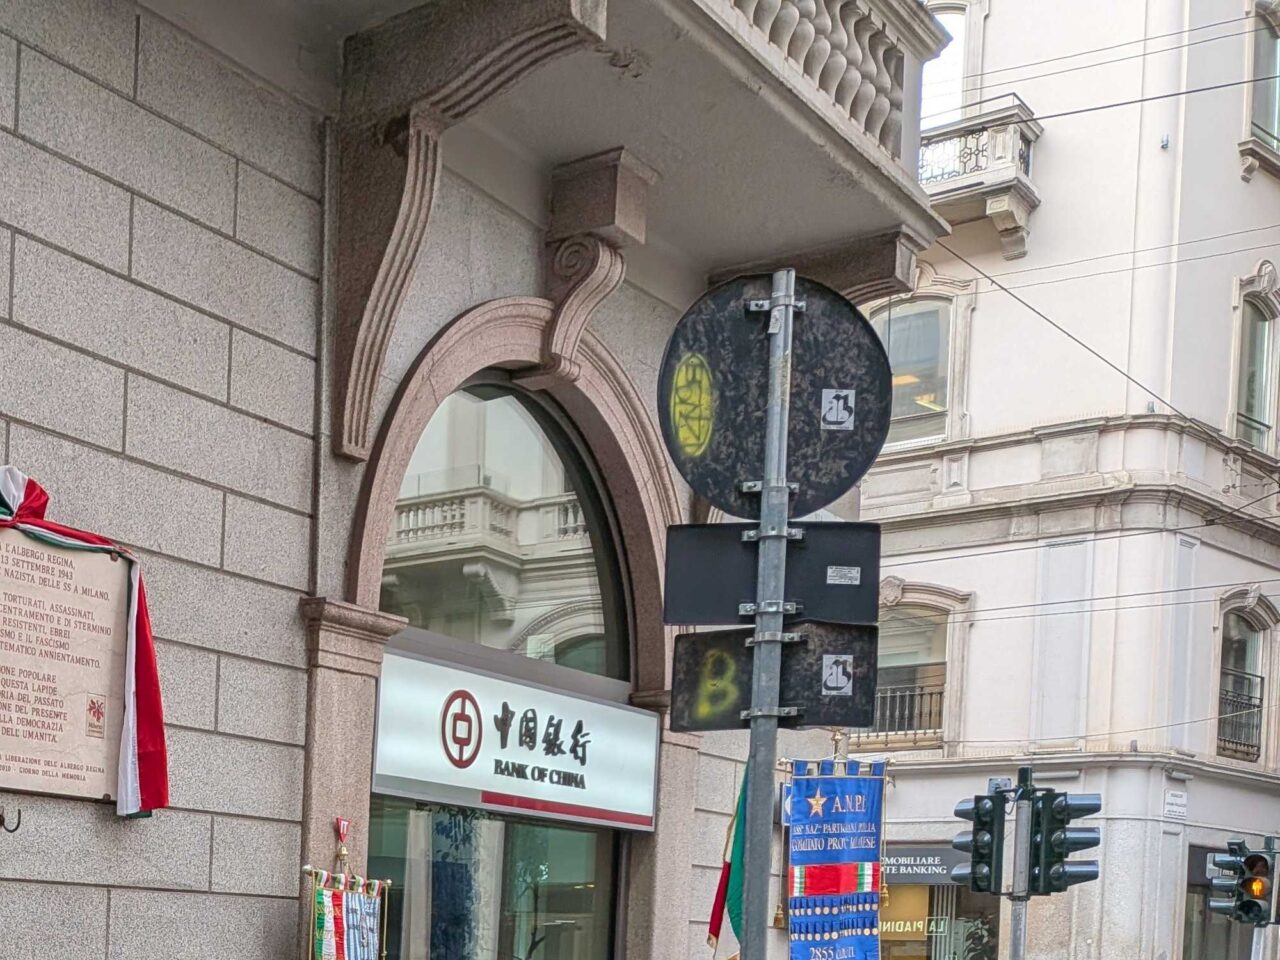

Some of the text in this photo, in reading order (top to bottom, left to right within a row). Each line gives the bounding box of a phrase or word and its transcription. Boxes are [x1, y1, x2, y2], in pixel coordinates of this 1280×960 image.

[0, 555, 9, 565] 13
[11, 558, 55, 576] SETTEMBRE
[58, 569, 73, 580] 1943
[47, 554, 76, 570] REGINA,
[4, 568, 36, 584] NAZISTA
[38, 576, 60, 590] DELLE
[63, 582, 71, 592] SS
[73, 585, 78, 594] A
[3, 592, 47, 611] TORTURATI,
[49, 603, 95, 621] ASSASSINATI,
[2, 617, 47, 635] RESISTENTI,
[50, 627, 71, 639] EBREI
[57, 616, 61, 625] E
[64, 617, 71, 627] DI
[73, 620, 112, 636] STERMINIO
[18, 632, 23, 641] E
[25, 634, 33, 643] IL
[35, 636, 70, 650] FASCISMO
[18, 668, 57, 684] POPOLARE
[0, 677, 29, 691] QUESTA
[31, 682, 58, 696] LAPIDE
[17, 692, 31, 703] DEL
[34, 695, 64, 708] PASSATO
[15, 704, 29, 715] DEL
[31, 707, 68, 721] PRESENTE
[16, 717, 63, 732] DEMOCRAZIA
[493, 701, 591, 767] 中国银行
[494, 758, 586, 790] BANK OF CHINA
[900, 865, 947, 874] BANKING
